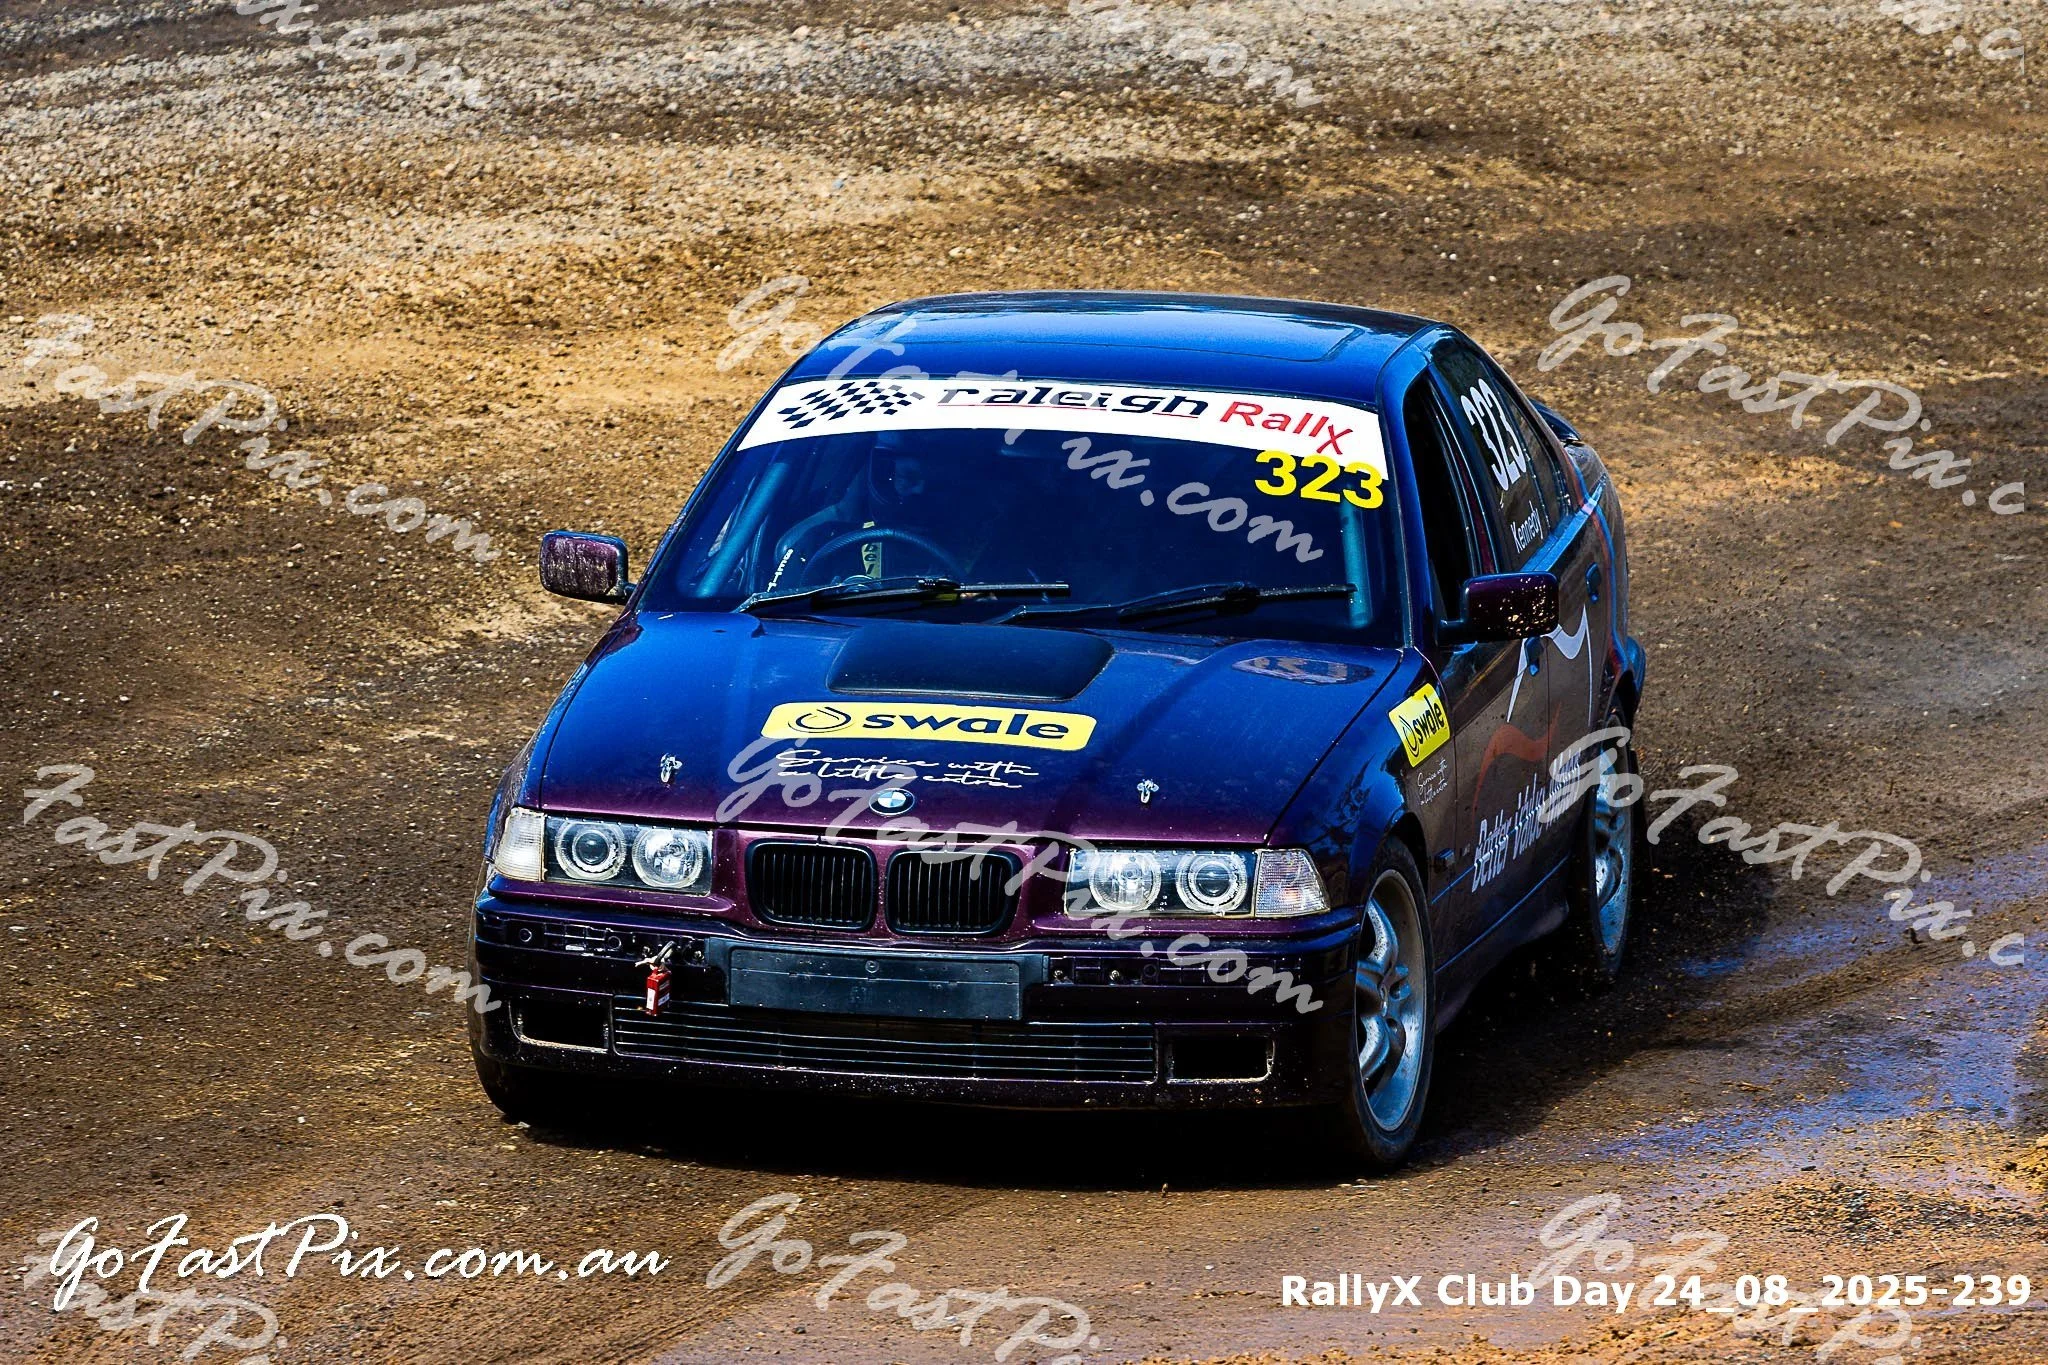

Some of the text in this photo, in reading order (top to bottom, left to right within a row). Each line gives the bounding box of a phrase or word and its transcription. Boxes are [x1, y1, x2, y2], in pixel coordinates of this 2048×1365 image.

[938, 386, 1208, 414] raleigh
[1461, 378, 1526, 490] 323
[1255, 449, 1386, 509] 323
[1510, 500, 1543, 553] Kennedy
[862, 713, 1069, 739] swale
[1413, 694, 1445, 744] swale
[776, 750, 1039, 777] Service with
[817, 763, 918, 782] little
[923, 771, 1023, 788] extra
